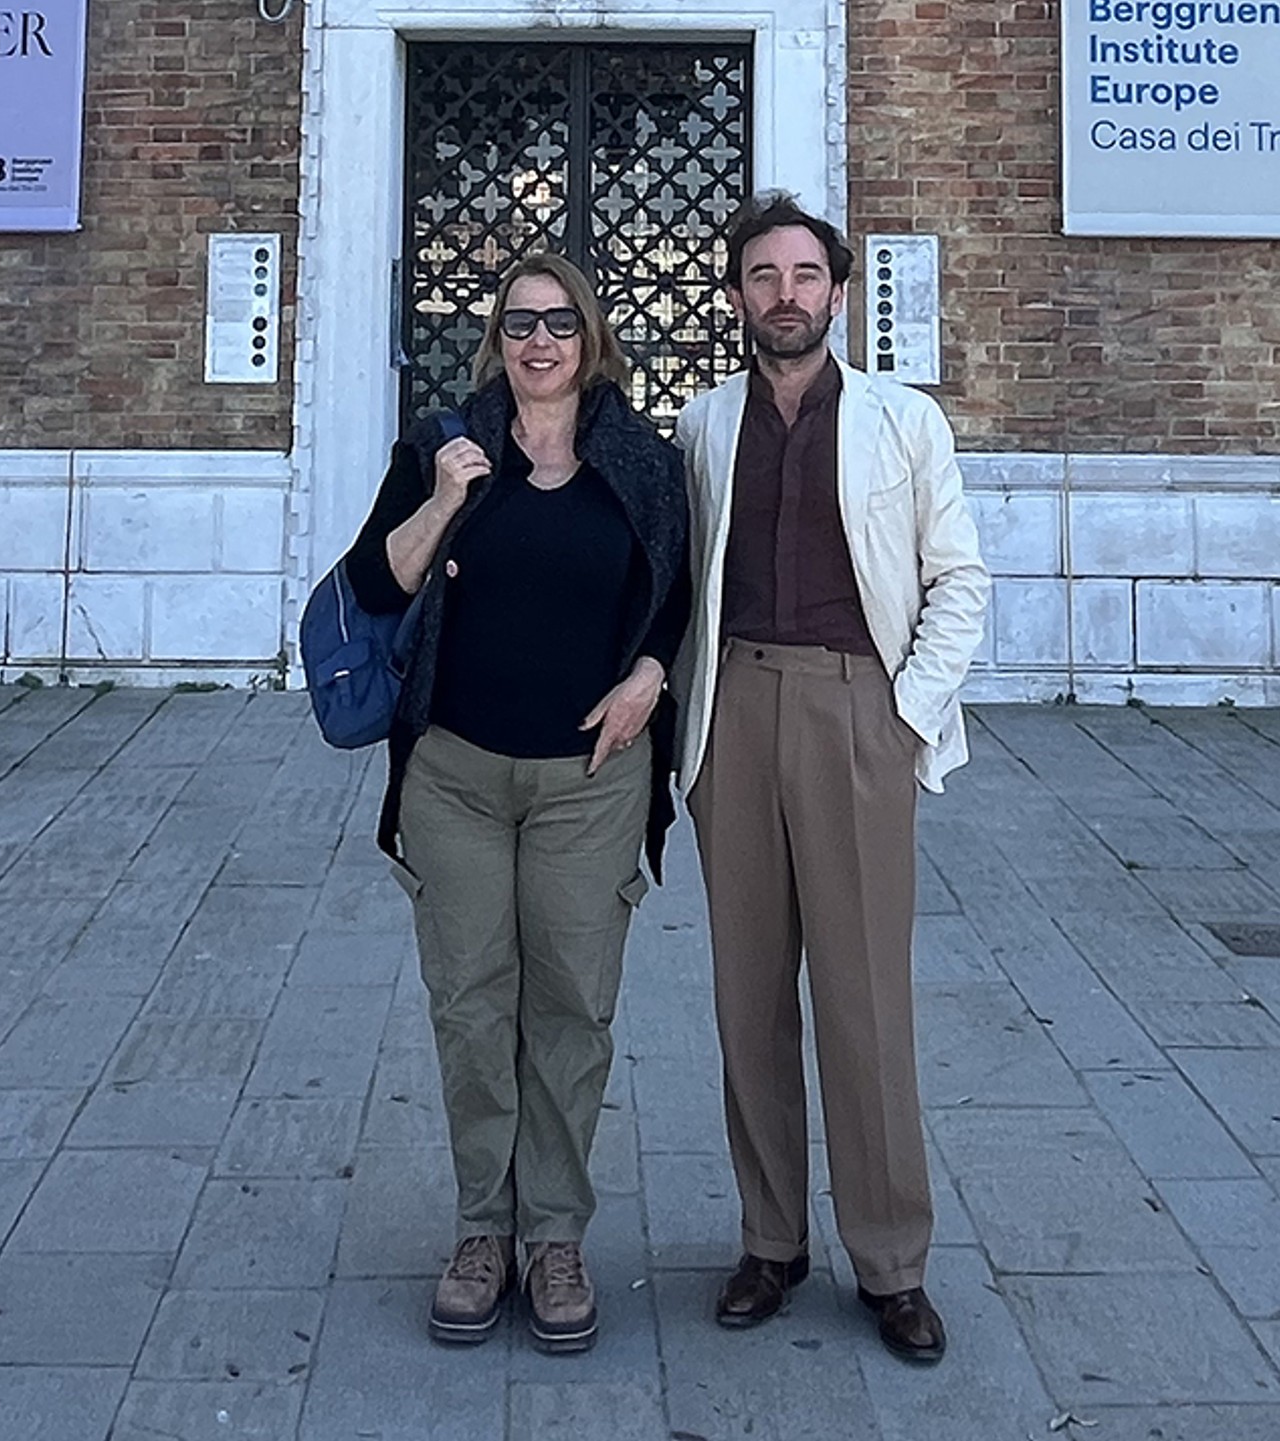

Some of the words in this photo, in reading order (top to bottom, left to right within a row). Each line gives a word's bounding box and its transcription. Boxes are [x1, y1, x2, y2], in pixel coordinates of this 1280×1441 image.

[1090, 33, 1239, 64] Institute
[1090, 75, 1219, 111] Europe
[1090, 119, 1177, 151] Casa
[1187, 121, 1240, 152] dei
